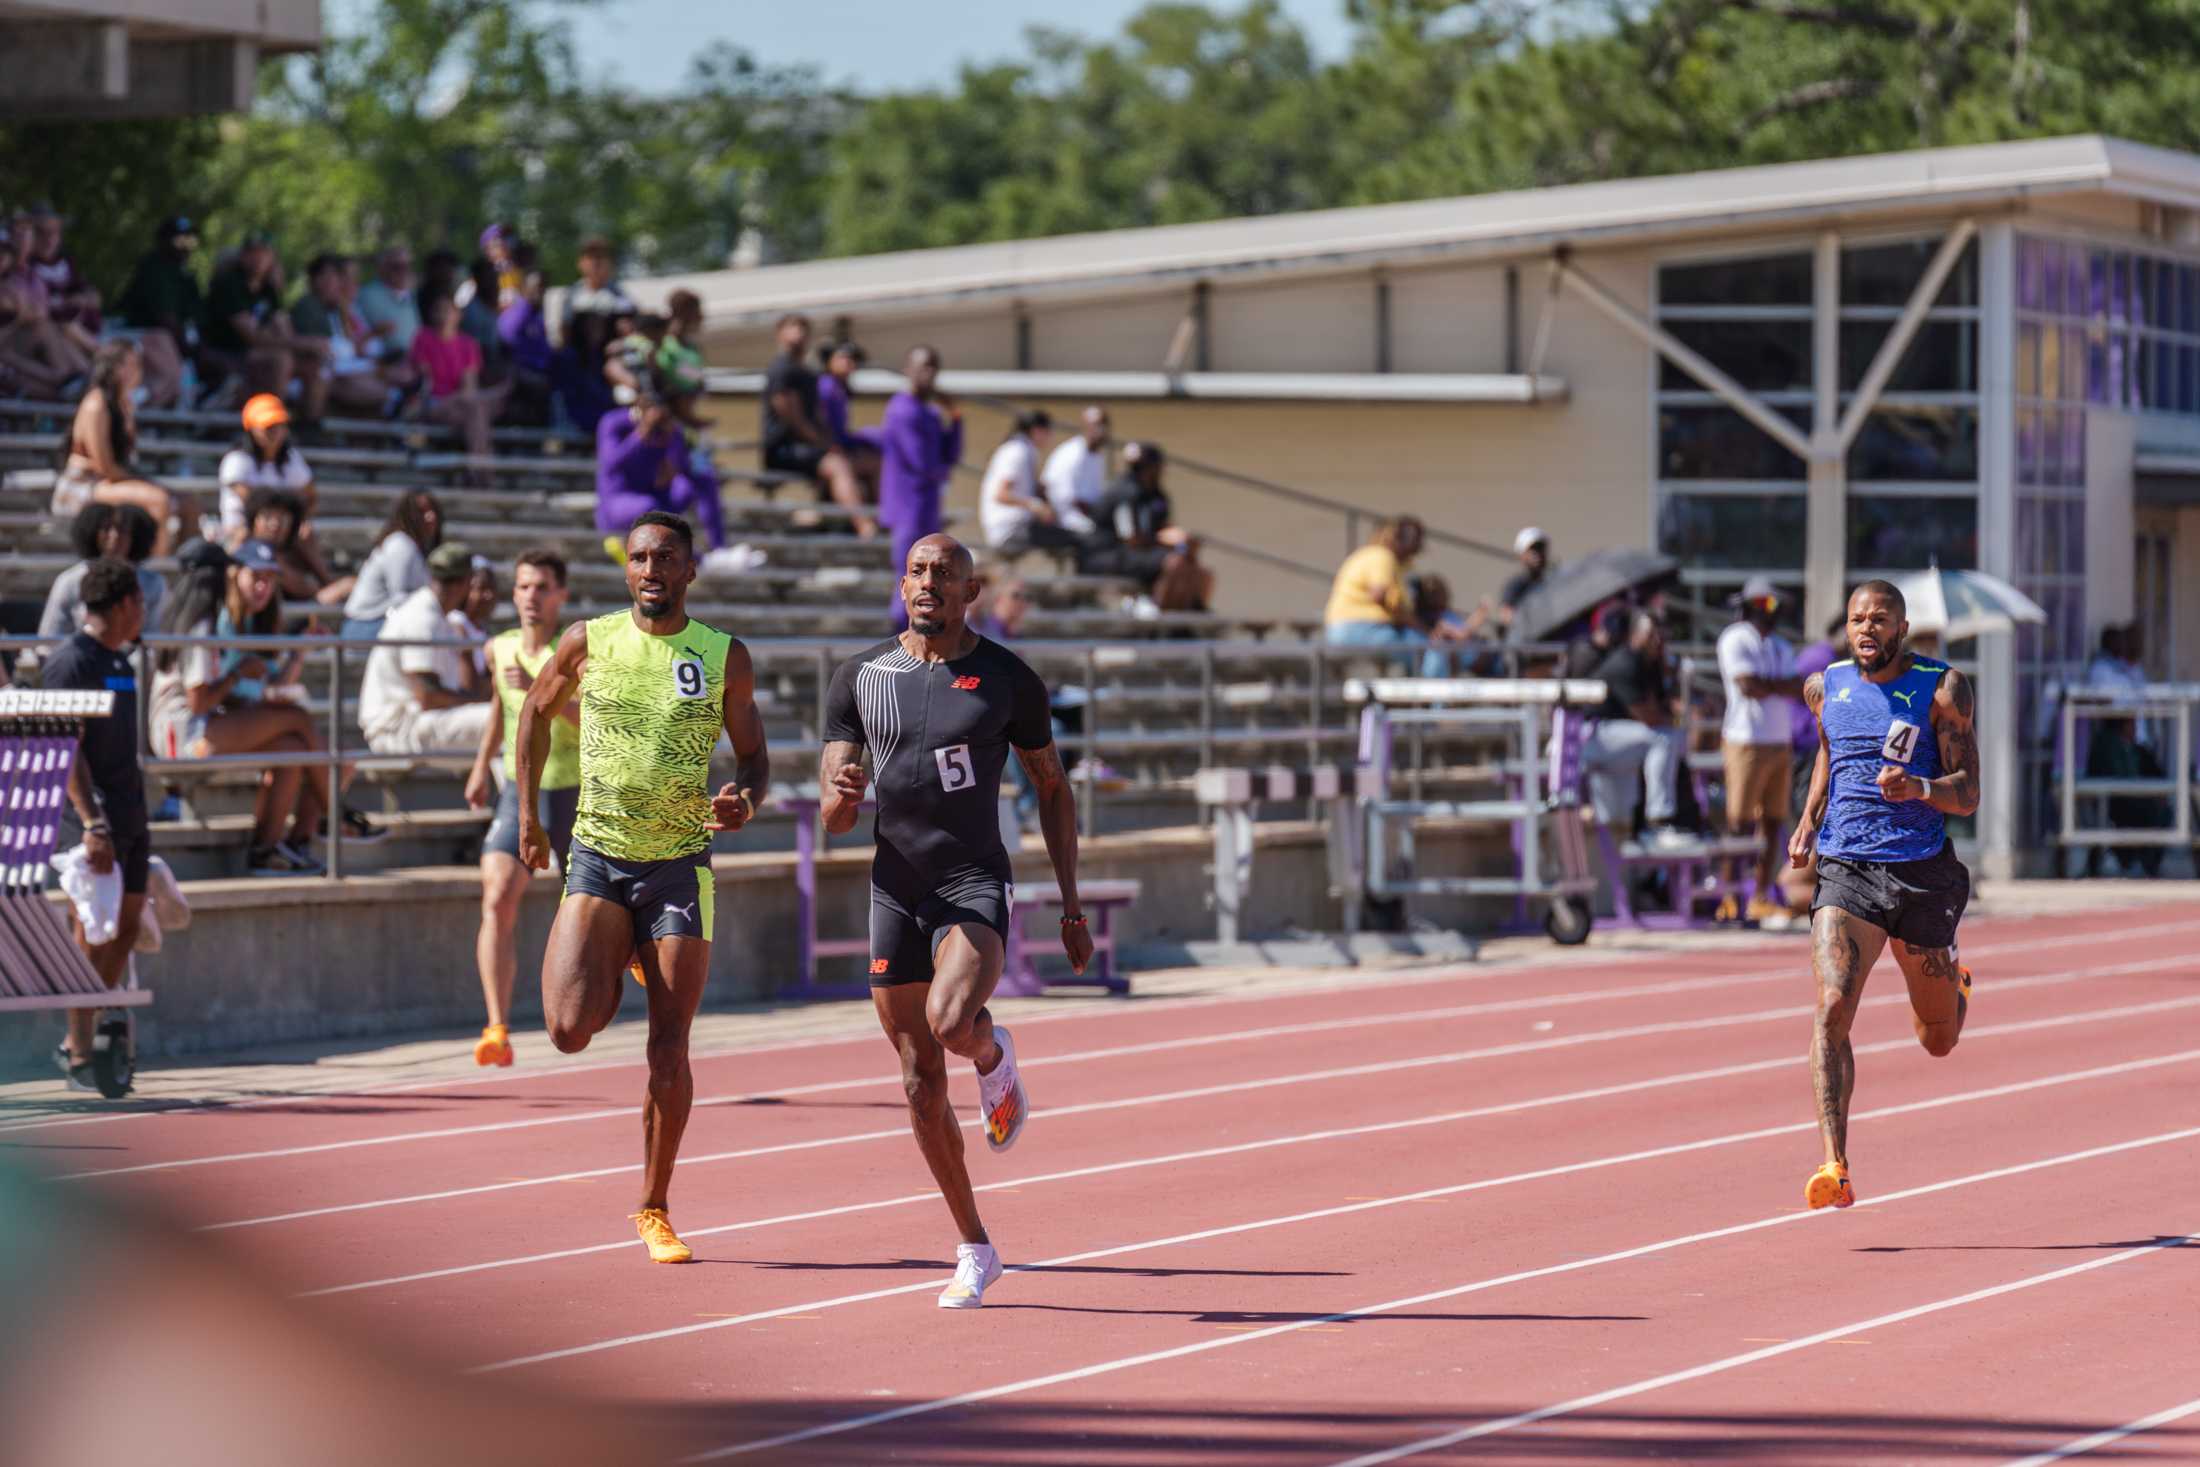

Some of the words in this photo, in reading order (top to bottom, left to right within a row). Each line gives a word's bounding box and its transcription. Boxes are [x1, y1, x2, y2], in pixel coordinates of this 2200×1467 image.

[678, 662, 701, 695] 9
[950, 674, 980, 690] NB
[1889, 726, 1912, 759] 4
[944, 747, 967, 788] 5
